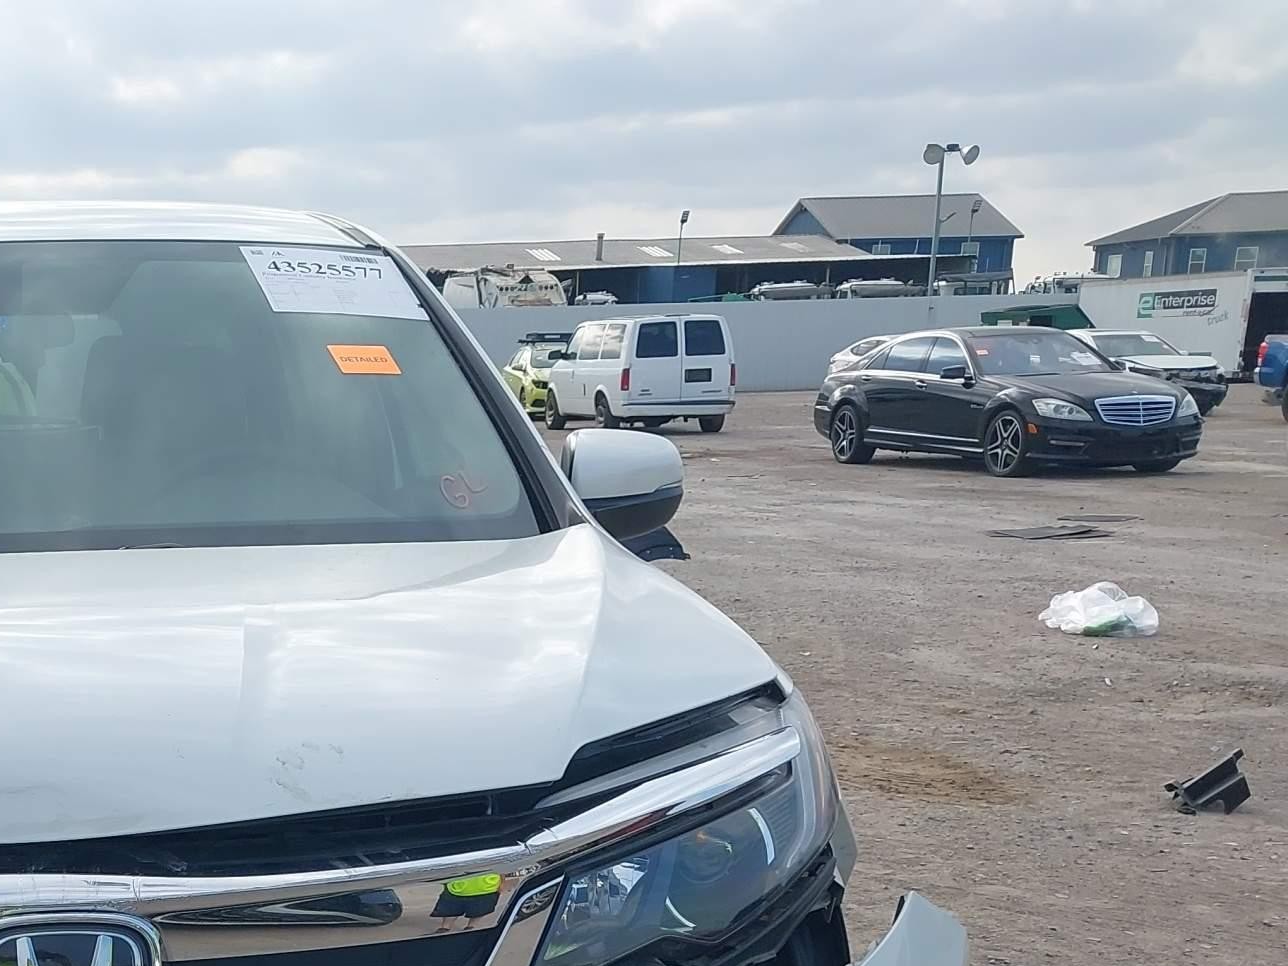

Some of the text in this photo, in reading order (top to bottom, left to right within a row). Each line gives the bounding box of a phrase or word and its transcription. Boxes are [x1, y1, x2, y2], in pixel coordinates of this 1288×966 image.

[268, 260, 383, 280] 43525577
[1154, 292, 1215, 310] Enterprise
[339, 355, 388, 364] DETAILED
